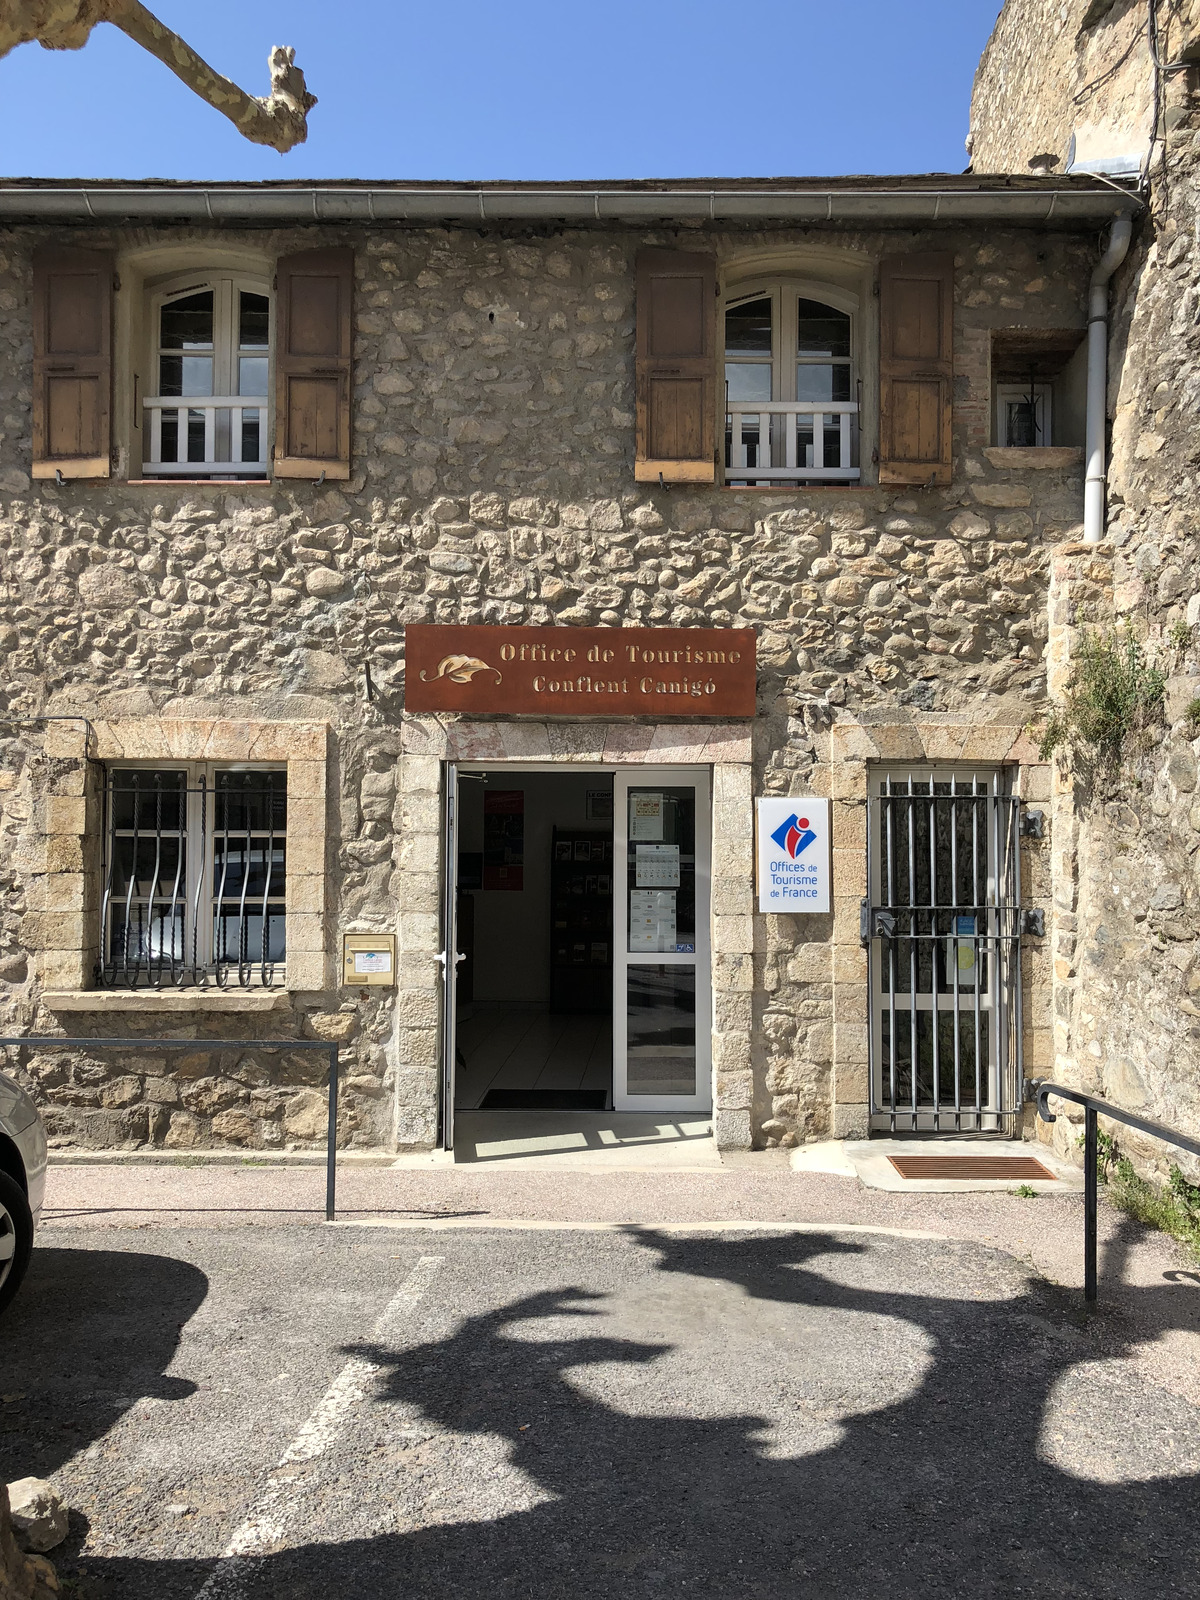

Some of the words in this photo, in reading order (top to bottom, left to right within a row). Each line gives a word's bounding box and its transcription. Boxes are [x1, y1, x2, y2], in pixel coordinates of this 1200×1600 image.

[500, 643, 577, 662] Office
[587, 645, 615, 663] de
[625, 645, 741, 664] Tourisme
[532, 675, 630, 693] Conflent
[639, 676, 716, 697] Canigó
[770, 861, 805, 872] Offices
[808, 864, 818, 872] de
[770, 874, 818, 885] Tourisme
[770, 889, 780, 898] de
[782, 886, 818, 898] France
